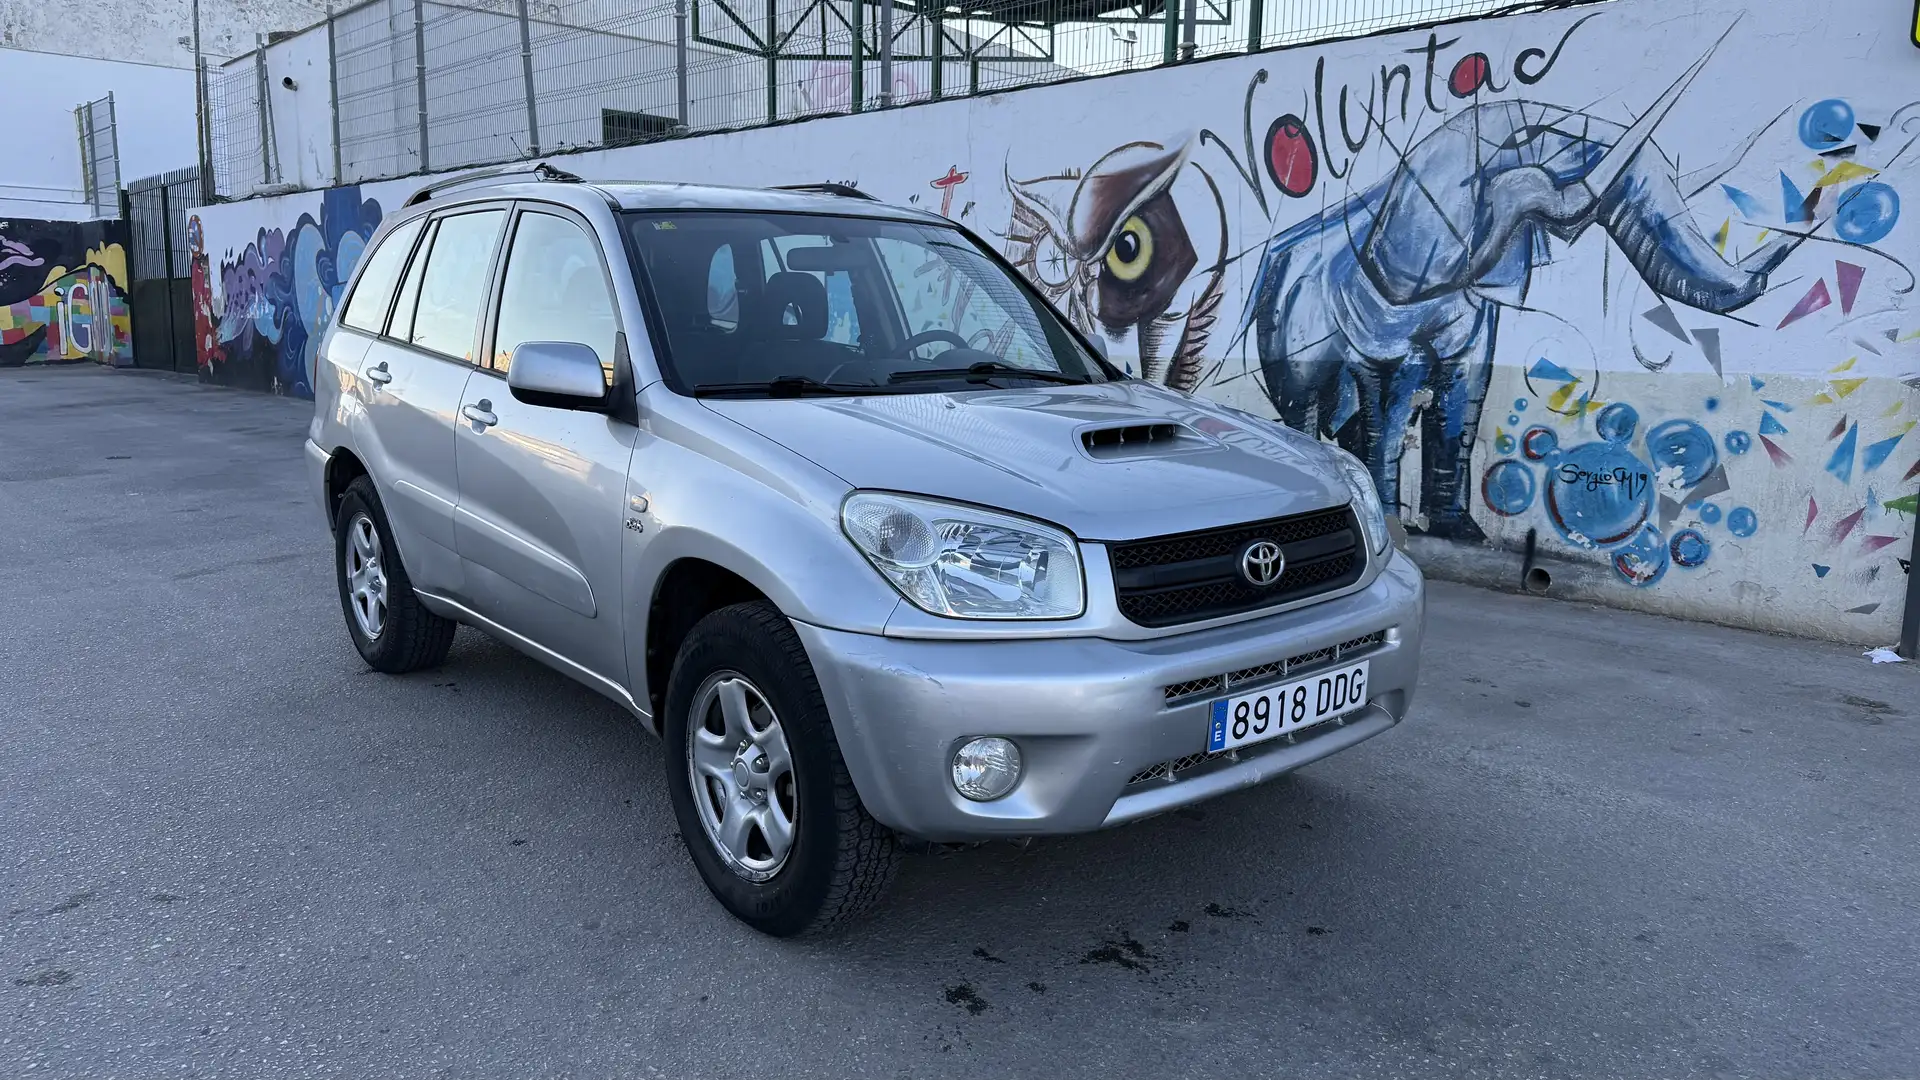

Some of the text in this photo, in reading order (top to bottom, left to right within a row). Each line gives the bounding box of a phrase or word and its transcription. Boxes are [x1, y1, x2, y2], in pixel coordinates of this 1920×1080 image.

[1559, 463, 1613, 492] Sergio
[1232, 668, 1363, 740] 8918 DDG
[1214, 730, 1222, 742] E
